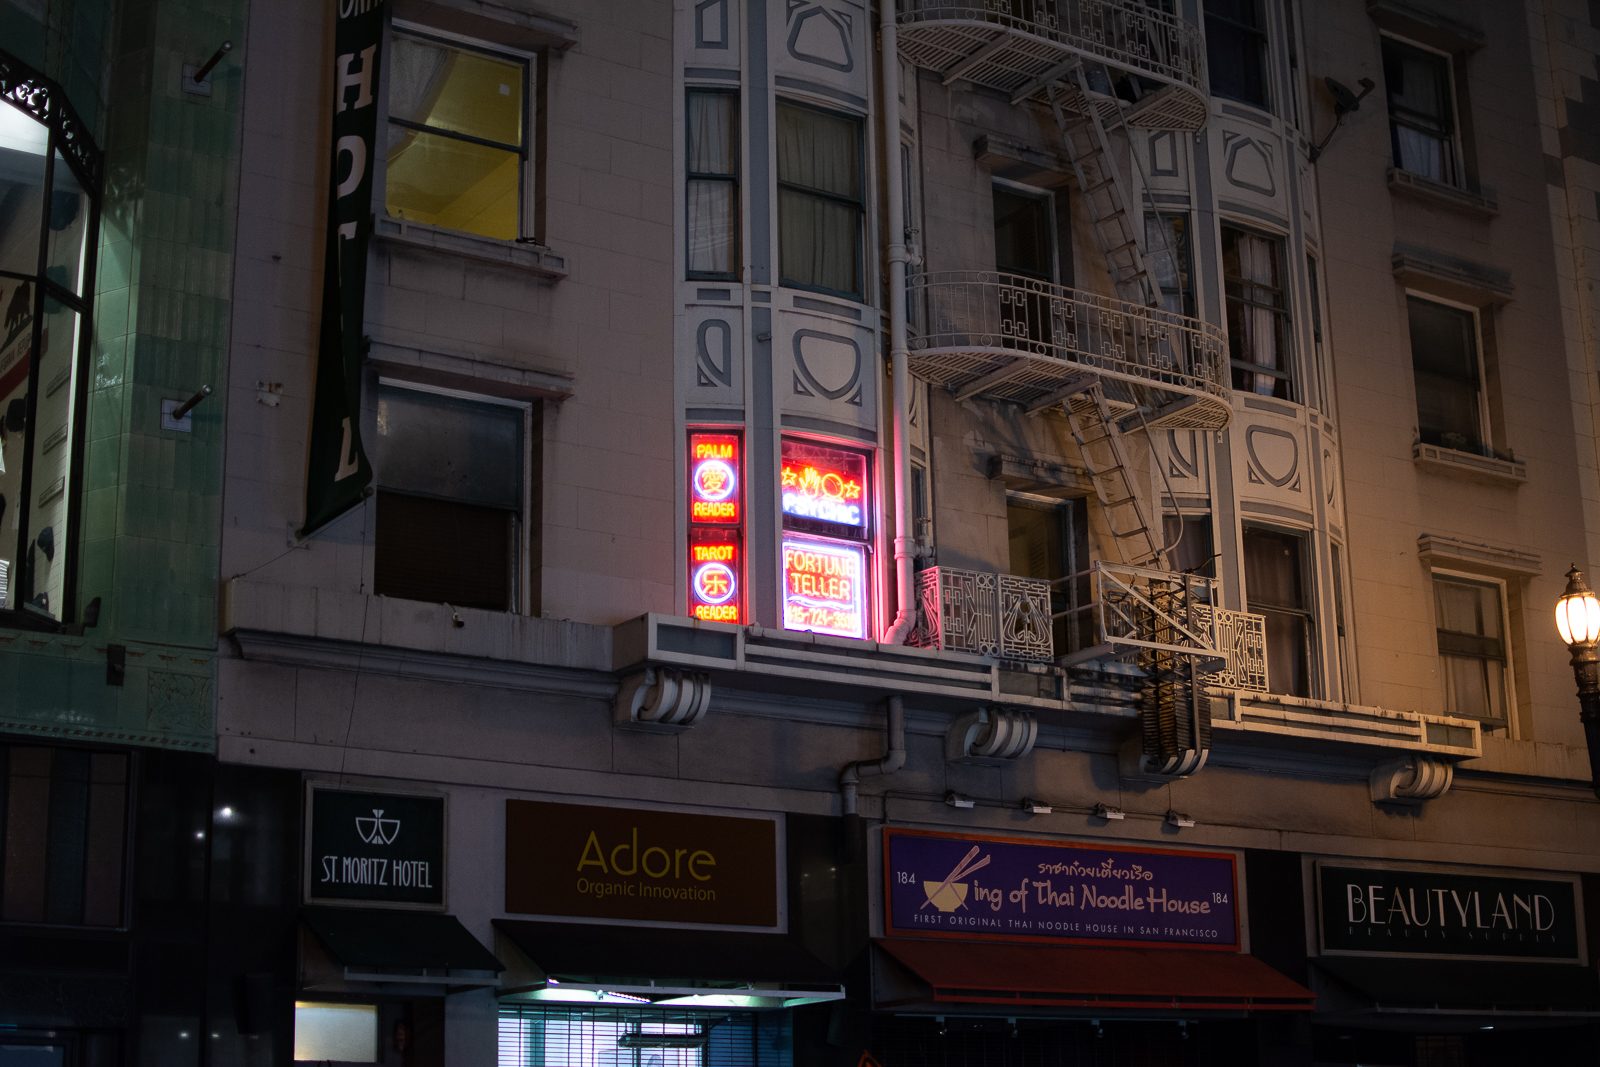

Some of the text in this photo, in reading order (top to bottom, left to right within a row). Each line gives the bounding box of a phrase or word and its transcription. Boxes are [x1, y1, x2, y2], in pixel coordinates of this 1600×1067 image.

[696, 444, 733, 459] PALM
[694, 502, 735, 517] READER
[782, 492, 860, 525] PSYCHIC
[694, 546, 734, 560] TAROT
[785, 550, 857, 577] FORTUNE
[790, 573, 851, 601] TELLER
[696, 605, 737, 620] READER
[576, 827, 717, 881] Adore
[321, 856, 433, 888] ST. MORITZ HOTEL
[897, 871, 916, 884] 184
[576, 878, 716, 901] Organic Innovation
[1009, 878, 1029, 913] of
[1032, 880, 1075, 908] Thai
[1080, 884, 1145, 910] Noodle
[1146, 887, 1211, 914] House
[1212, 893, 1228, 904] 184
[1346, 883, 1556, 931] BEAUTYLAND
[914, 914, 1218, 938] FIRST ORIGINAL THAI NOODLE HOUSE IN SAN FRANCISCO
